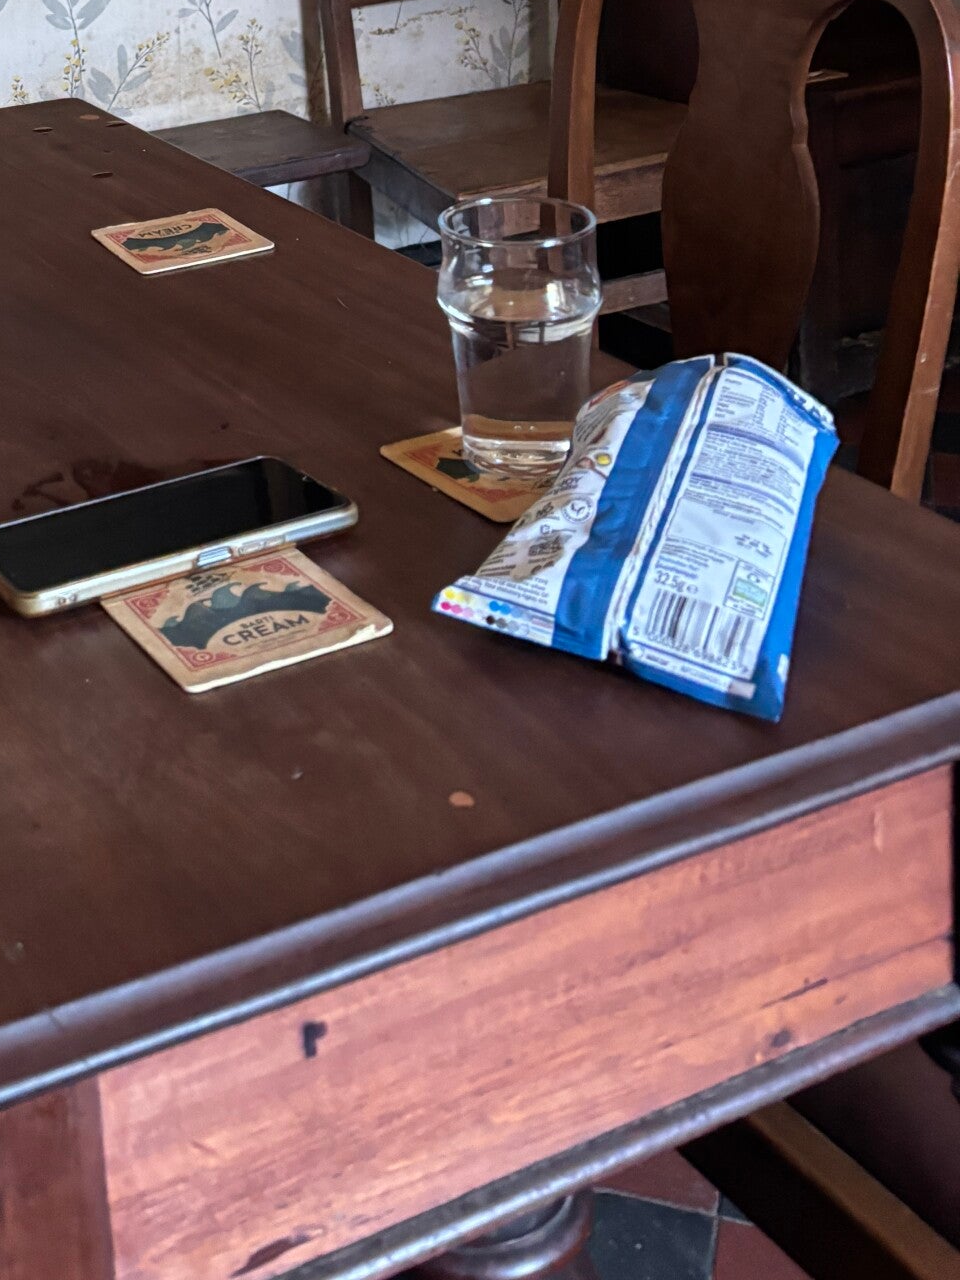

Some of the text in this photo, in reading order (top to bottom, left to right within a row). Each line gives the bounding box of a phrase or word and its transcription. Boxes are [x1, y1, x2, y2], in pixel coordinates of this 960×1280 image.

[138, 224, 192, 238] CREAM
[221, 613, 311, 647] CREAM
[239, 615, 275, 630] BARTI
